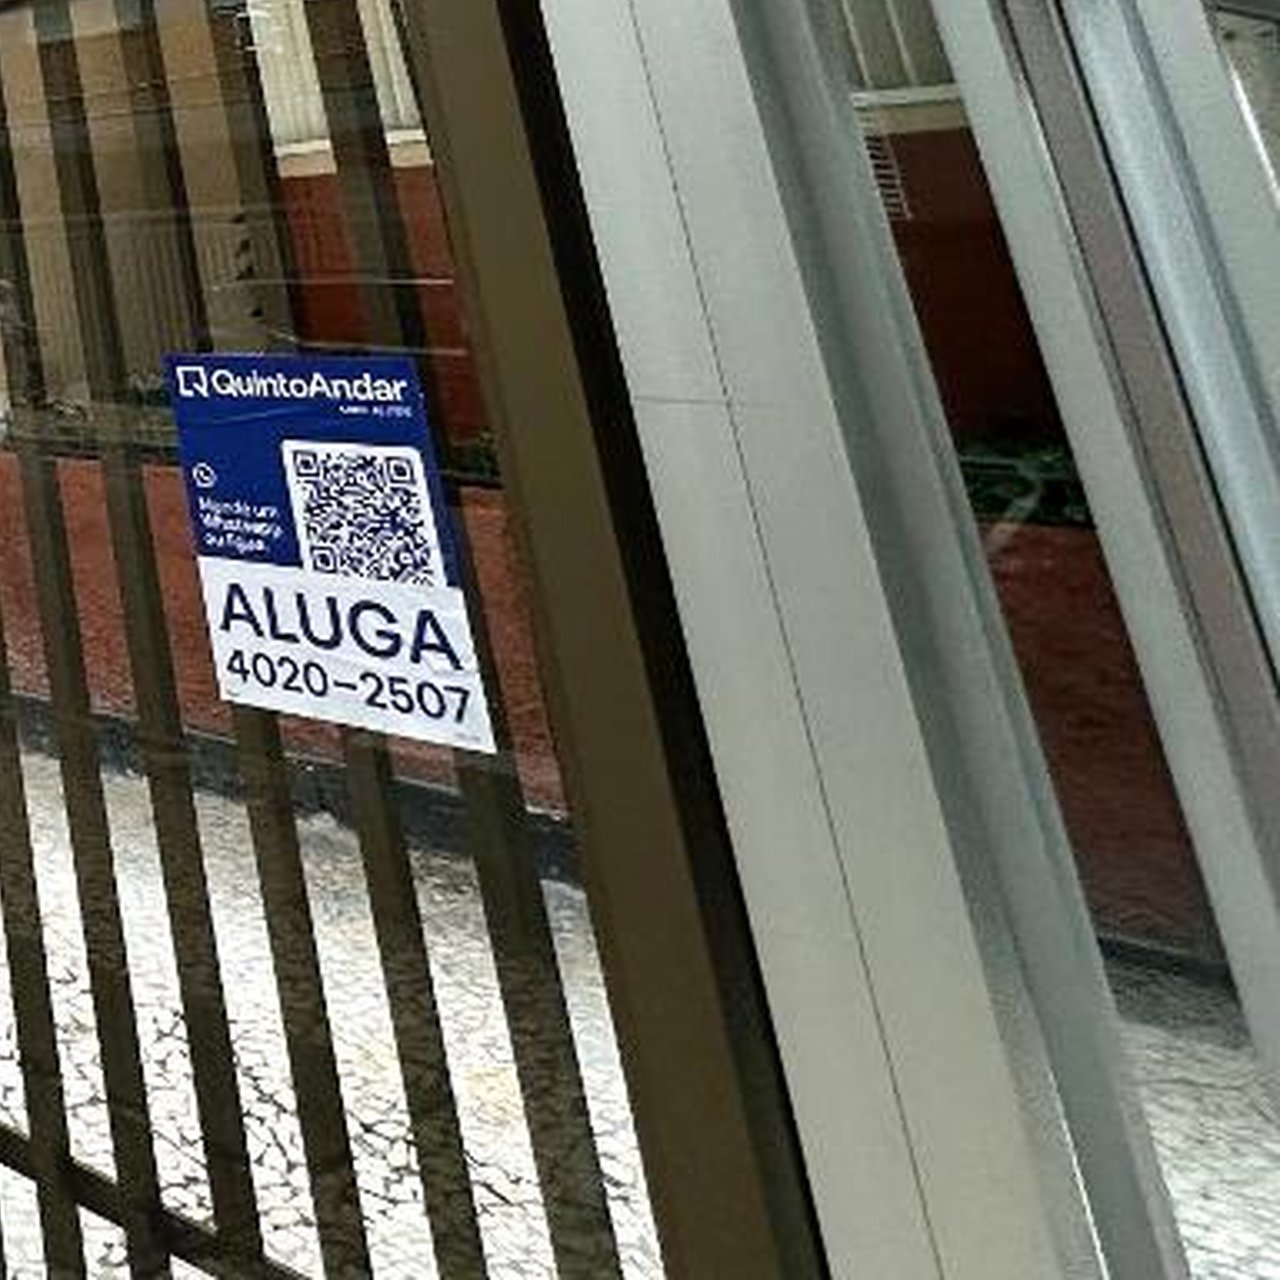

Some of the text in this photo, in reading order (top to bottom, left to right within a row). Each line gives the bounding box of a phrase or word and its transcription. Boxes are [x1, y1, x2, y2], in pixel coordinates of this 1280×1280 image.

[211, 369, 407, 402] QuintoAndar
[219, 582, 464, 671] ALUGA
[226, 649, 471, 725] 4020-2507
